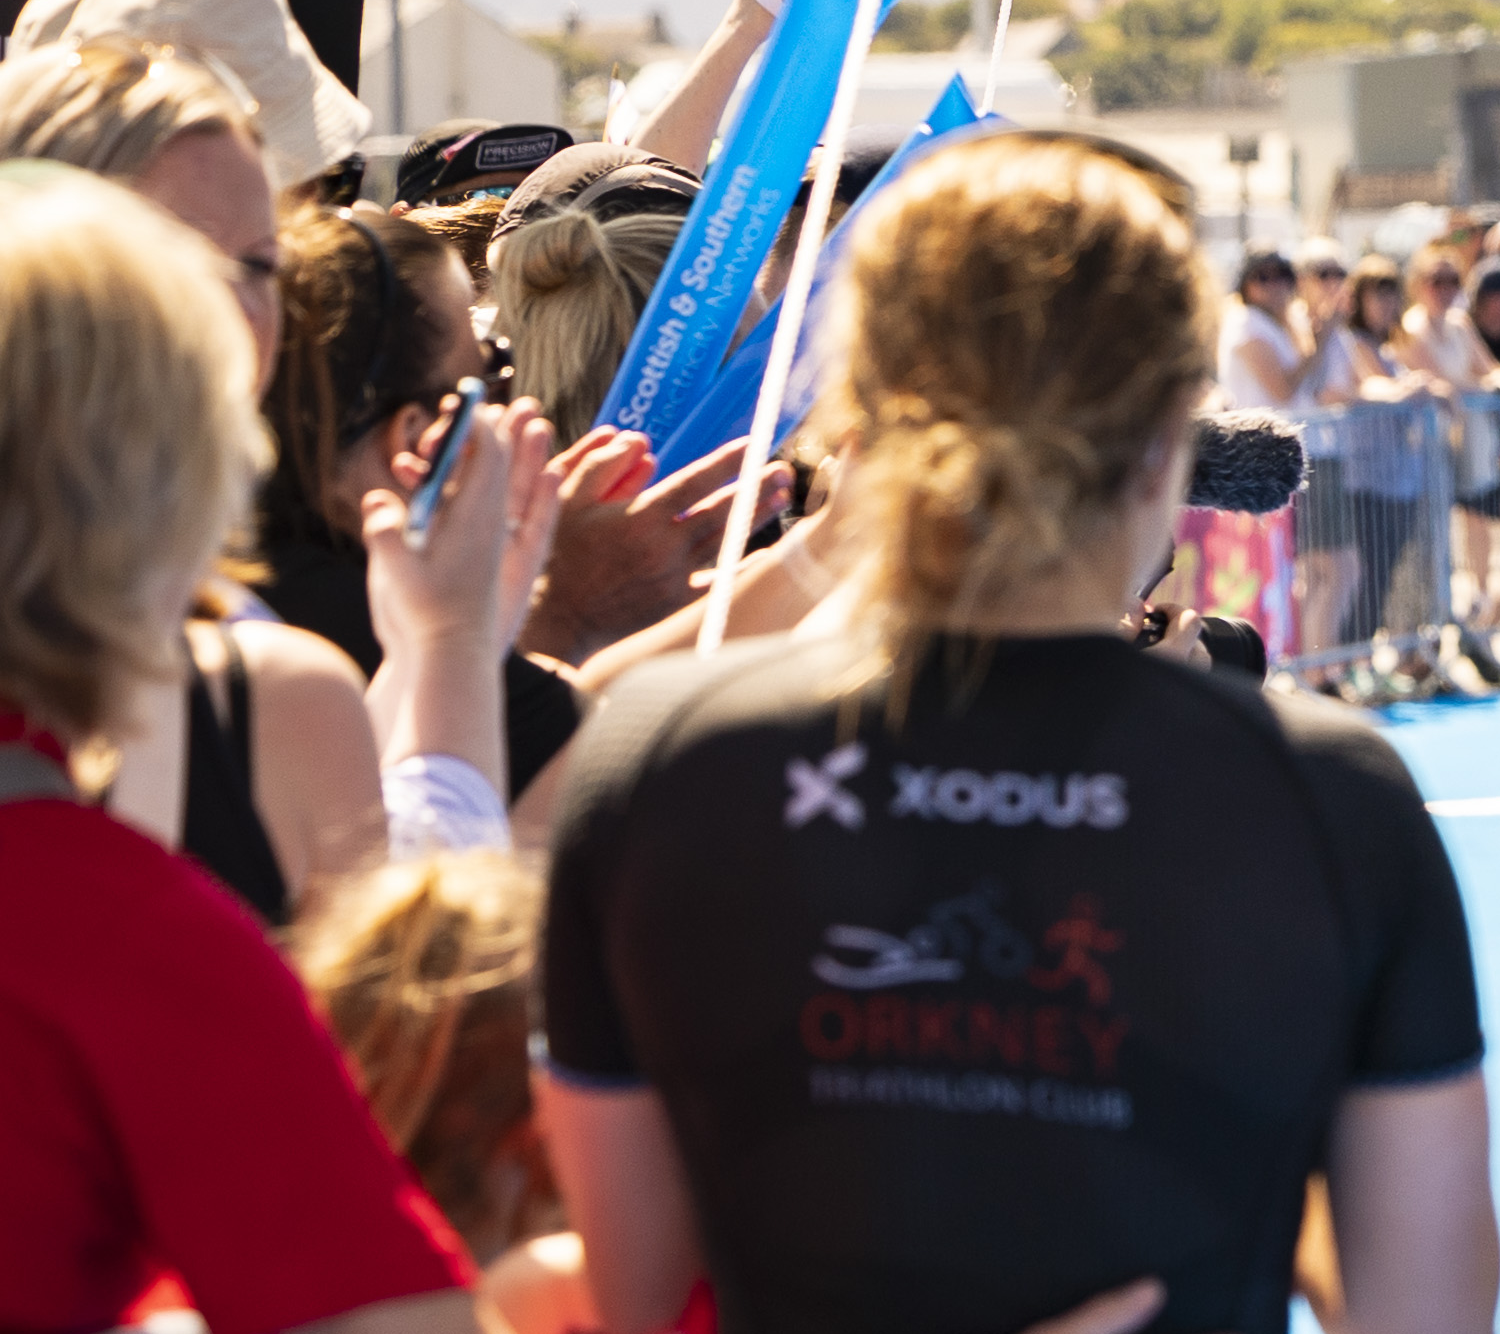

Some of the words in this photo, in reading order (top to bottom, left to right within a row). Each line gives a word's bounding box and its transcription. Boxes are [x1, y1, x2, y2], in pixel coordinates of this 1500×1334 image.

[680, 164, 757, 292] Southern
[705, 186, 782, 309] Networks
[668, 292, 698, 318] &
[618, 317, 687, 430] Scottish
[801, 993, 1130, 1077] ORKNEY
